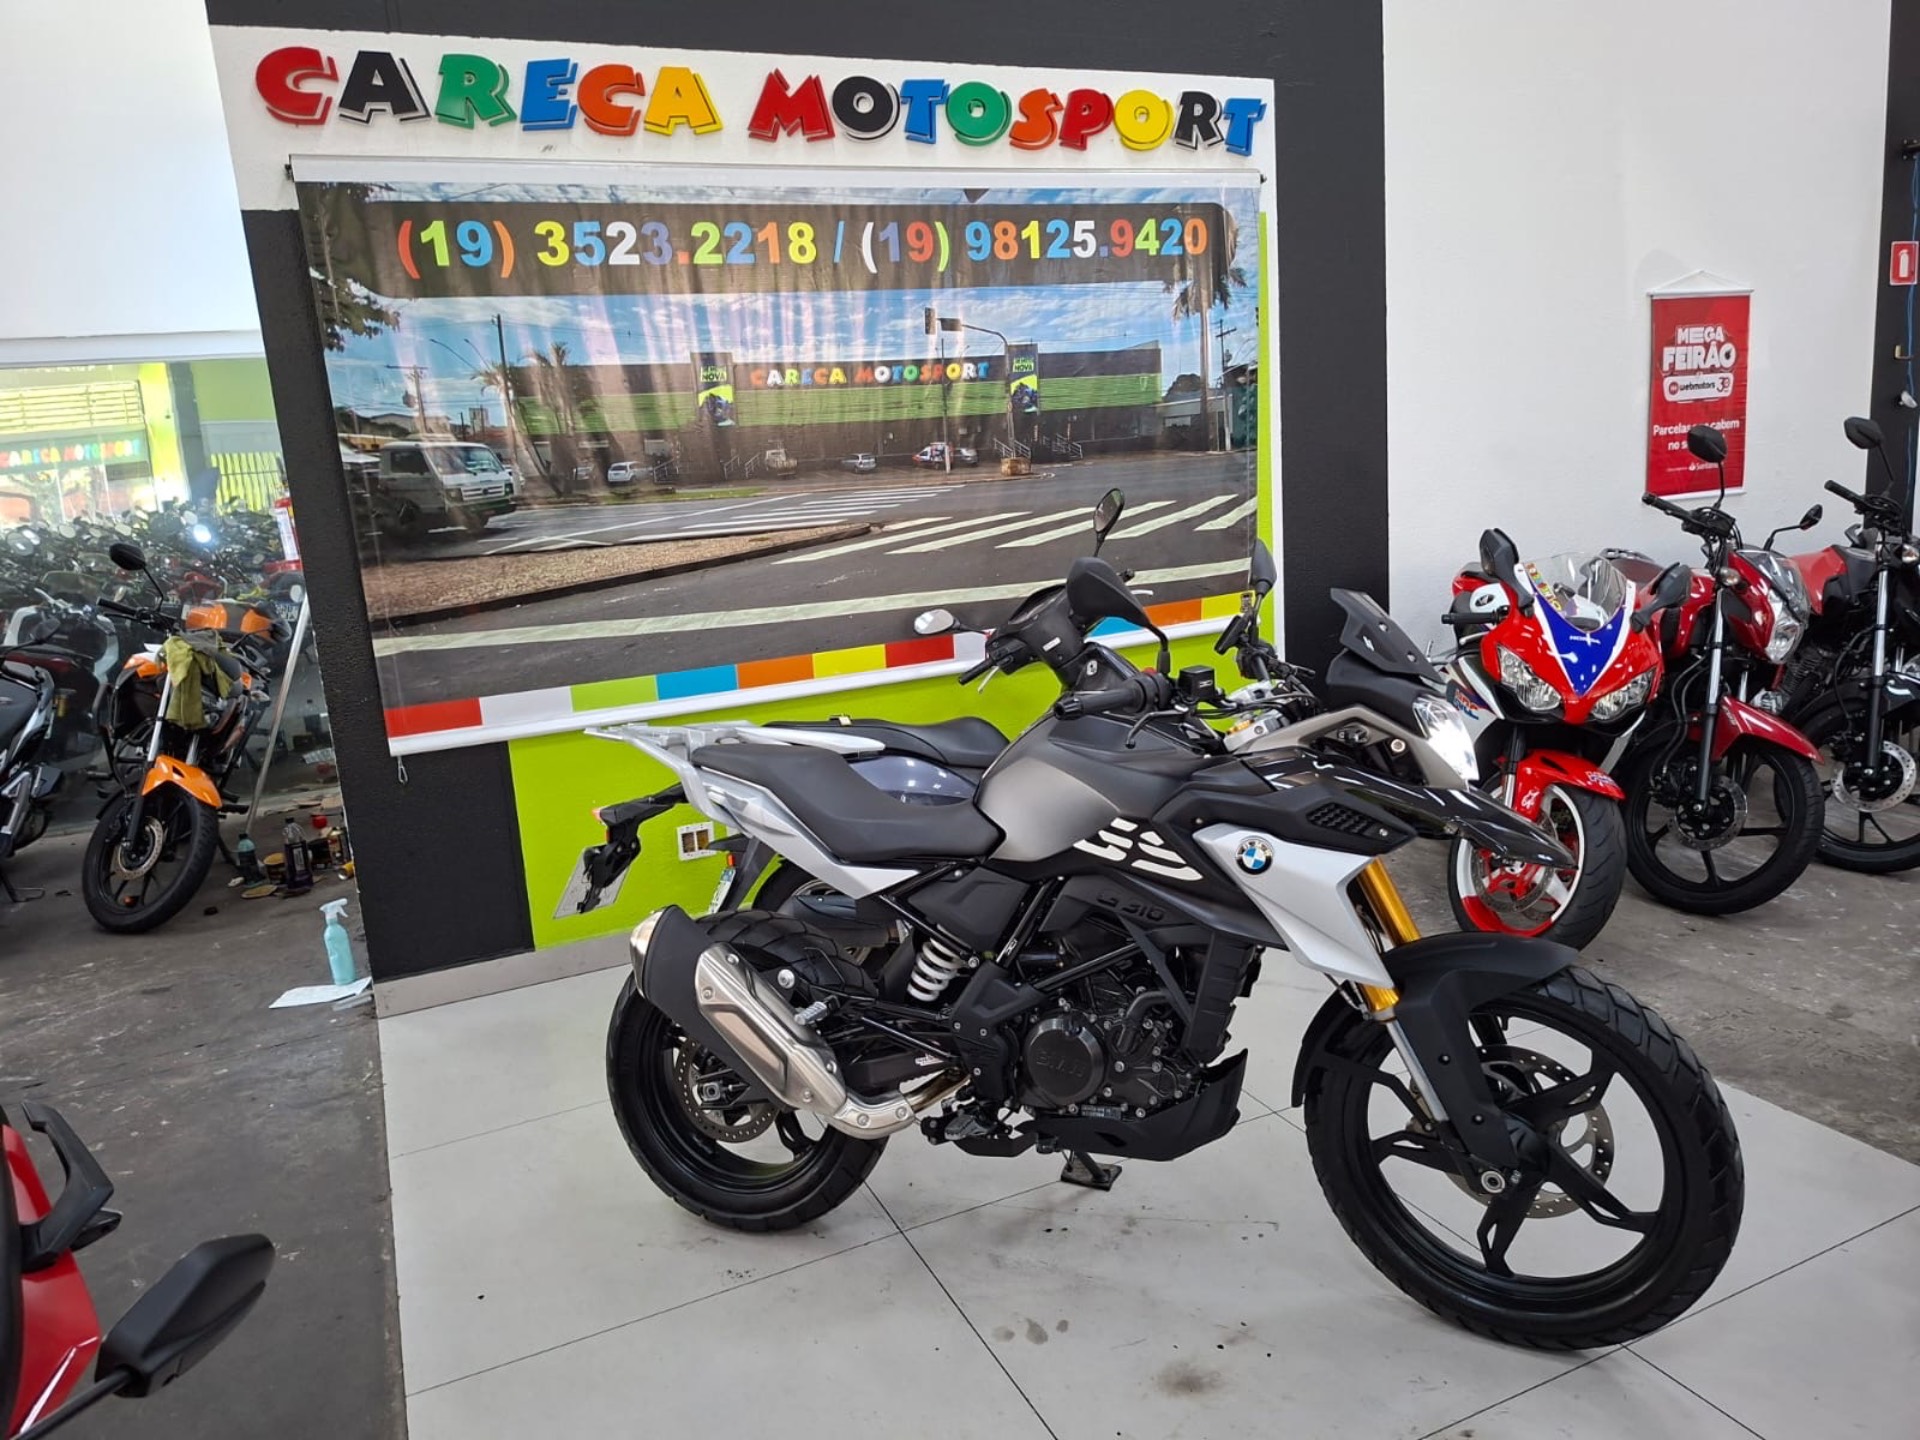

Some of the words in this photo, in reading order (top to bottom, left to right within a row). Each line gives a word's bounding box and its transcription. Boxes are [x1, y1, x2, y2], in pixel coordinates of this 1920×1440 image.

[255, 46, 722, 136] CARECA
[747, 68, 1266, 156] MOTOSPORT
[398, 219, 516, 278] (19)
[534, 221, 817, 267] 3523.2218
[833, 221, 845, 263] /
[862, 221, 949, 273] (19)
[965, 217, 1207, 262] 98125.9420
[1677, 326, 1724, 344] MEGA
[1662, 341, 1736, 371] FEIRÃO
[750, 367, 848, 386] CARECA
[855, 362, 990, 383] MOTOSPORT
